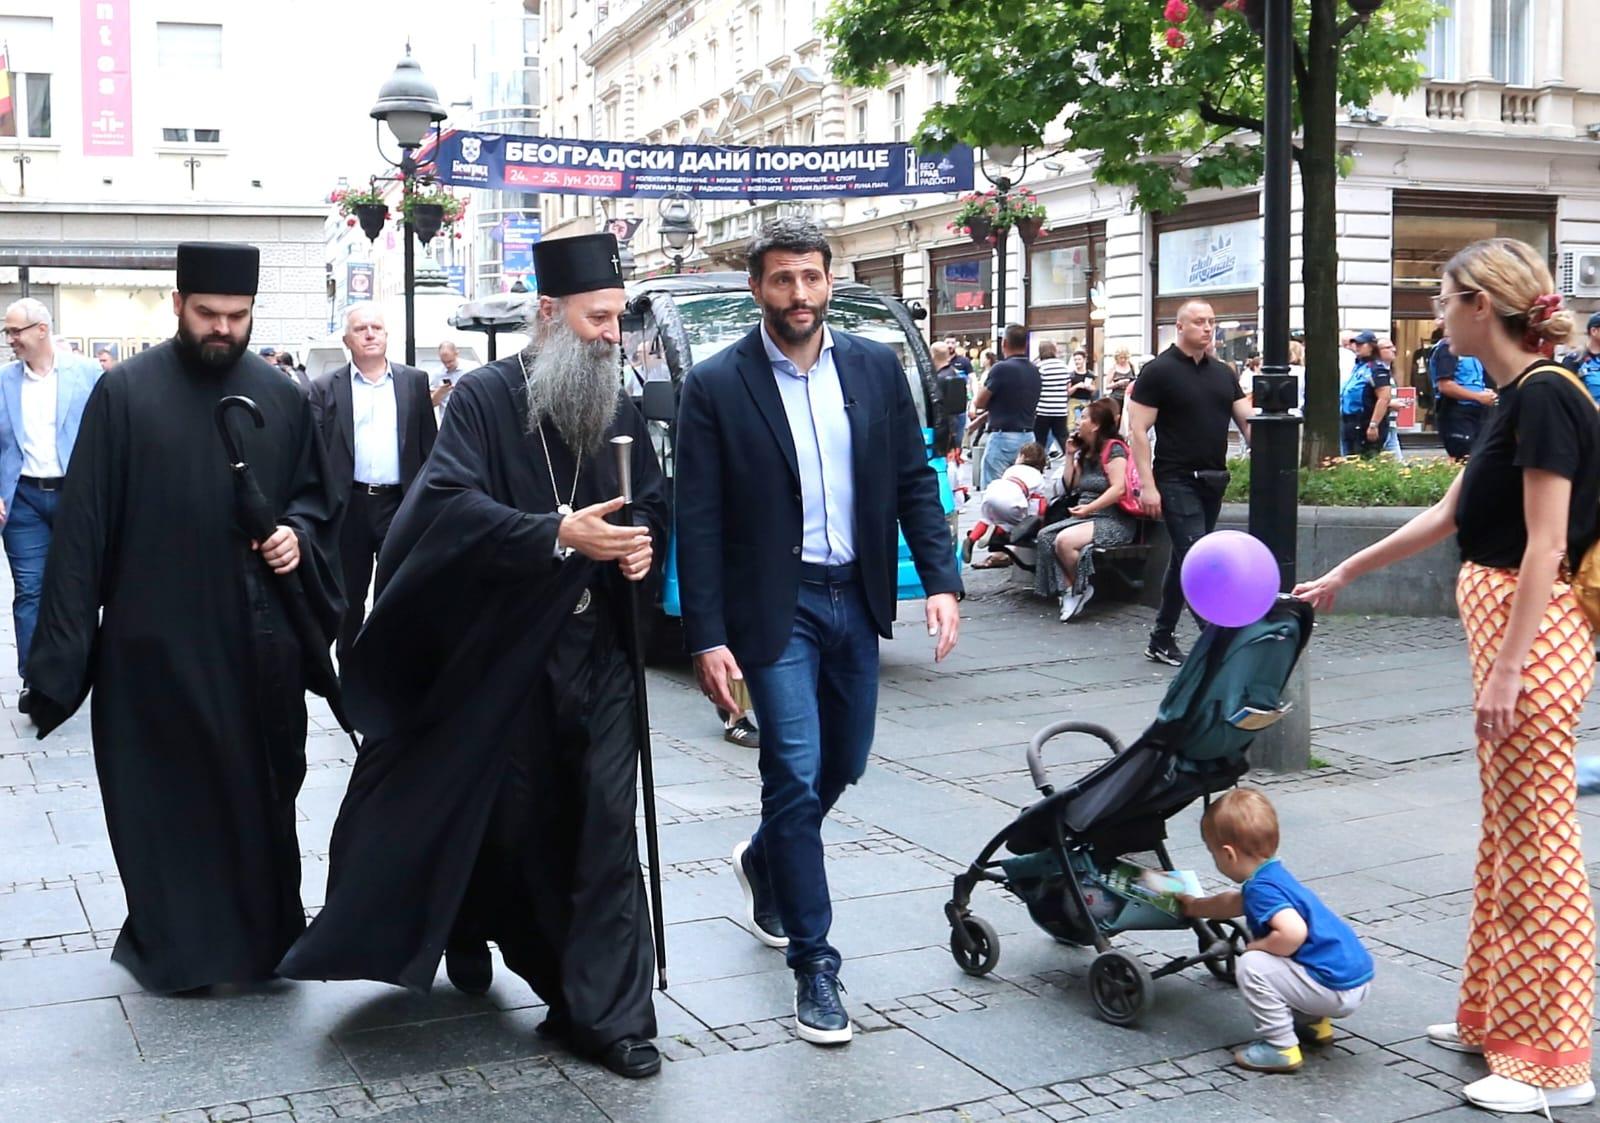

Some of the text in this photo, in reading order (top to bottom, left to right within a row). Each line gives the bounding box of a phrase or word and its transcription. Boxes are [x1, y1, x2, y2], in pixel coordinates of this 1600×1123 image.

[505, 142, 890, 173] БЕОГРАДСКИ ДАНИ ПОРОДИЦЕ
[452, 160, 489, 178] Београд
[510, 170, 528, 181] 24.
[542, 172, 560, 183] 25.
[563, 173, 581, 186] јун
[584, 174, 616, 186] 2023.
[920, 176, 956, 186] РАДОСТИ
